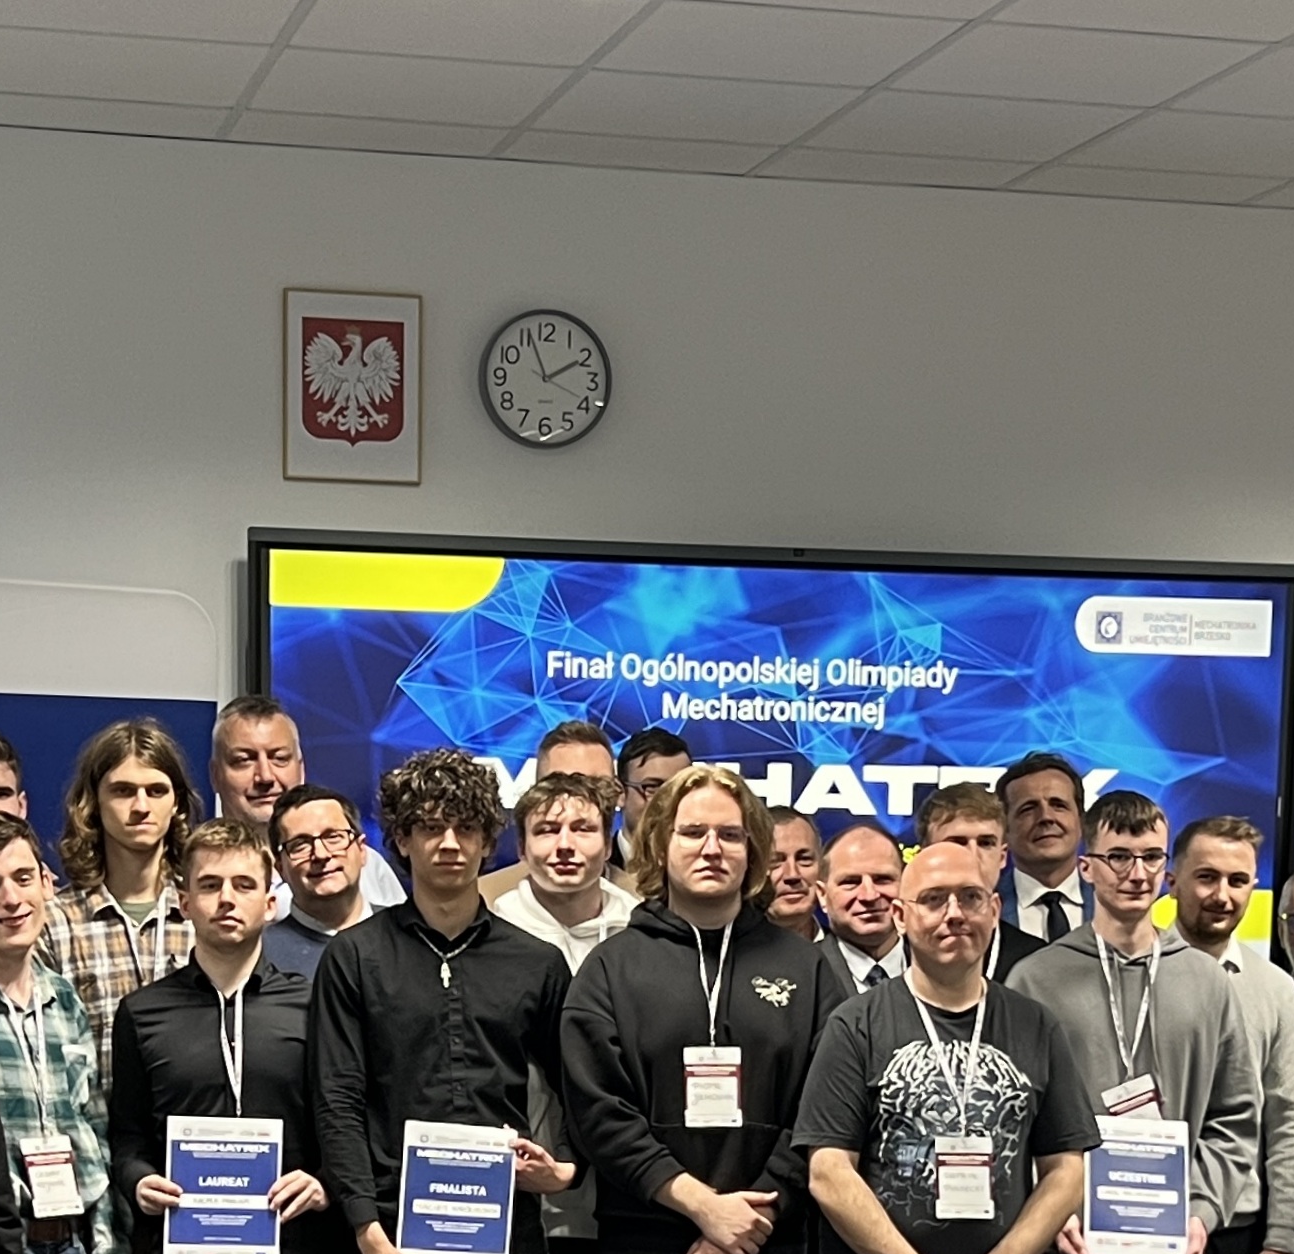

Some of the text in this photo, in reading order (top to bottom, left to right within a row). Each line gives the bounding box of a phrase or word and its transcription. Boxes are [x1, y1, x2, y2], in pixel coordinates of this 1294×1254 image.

[519, 328, 531, 348] 11
[538, 322, 556, 343] 12
[500, 345, 520, 365] 10
[578, 347, 592, 368] 2
[493, 367, 507, 387] 9
[586, 372, 599, 392] 3
[500, 391, 514, 411] 8
[576, 395, 591, 415] 4
[517, 408, 530, 429] 7
[538, 417, 553, 437] 6
[560, 411, 574, 432] 5
[546, 650, 958, 695] Finał Ogólnopolskiej Olimpiady
[661, 692, 886, 730] Mechatronicznej
[198, 1176, 251, 1188] LAUREAT
[429, 1182, 487, 1197] FINALISTA
